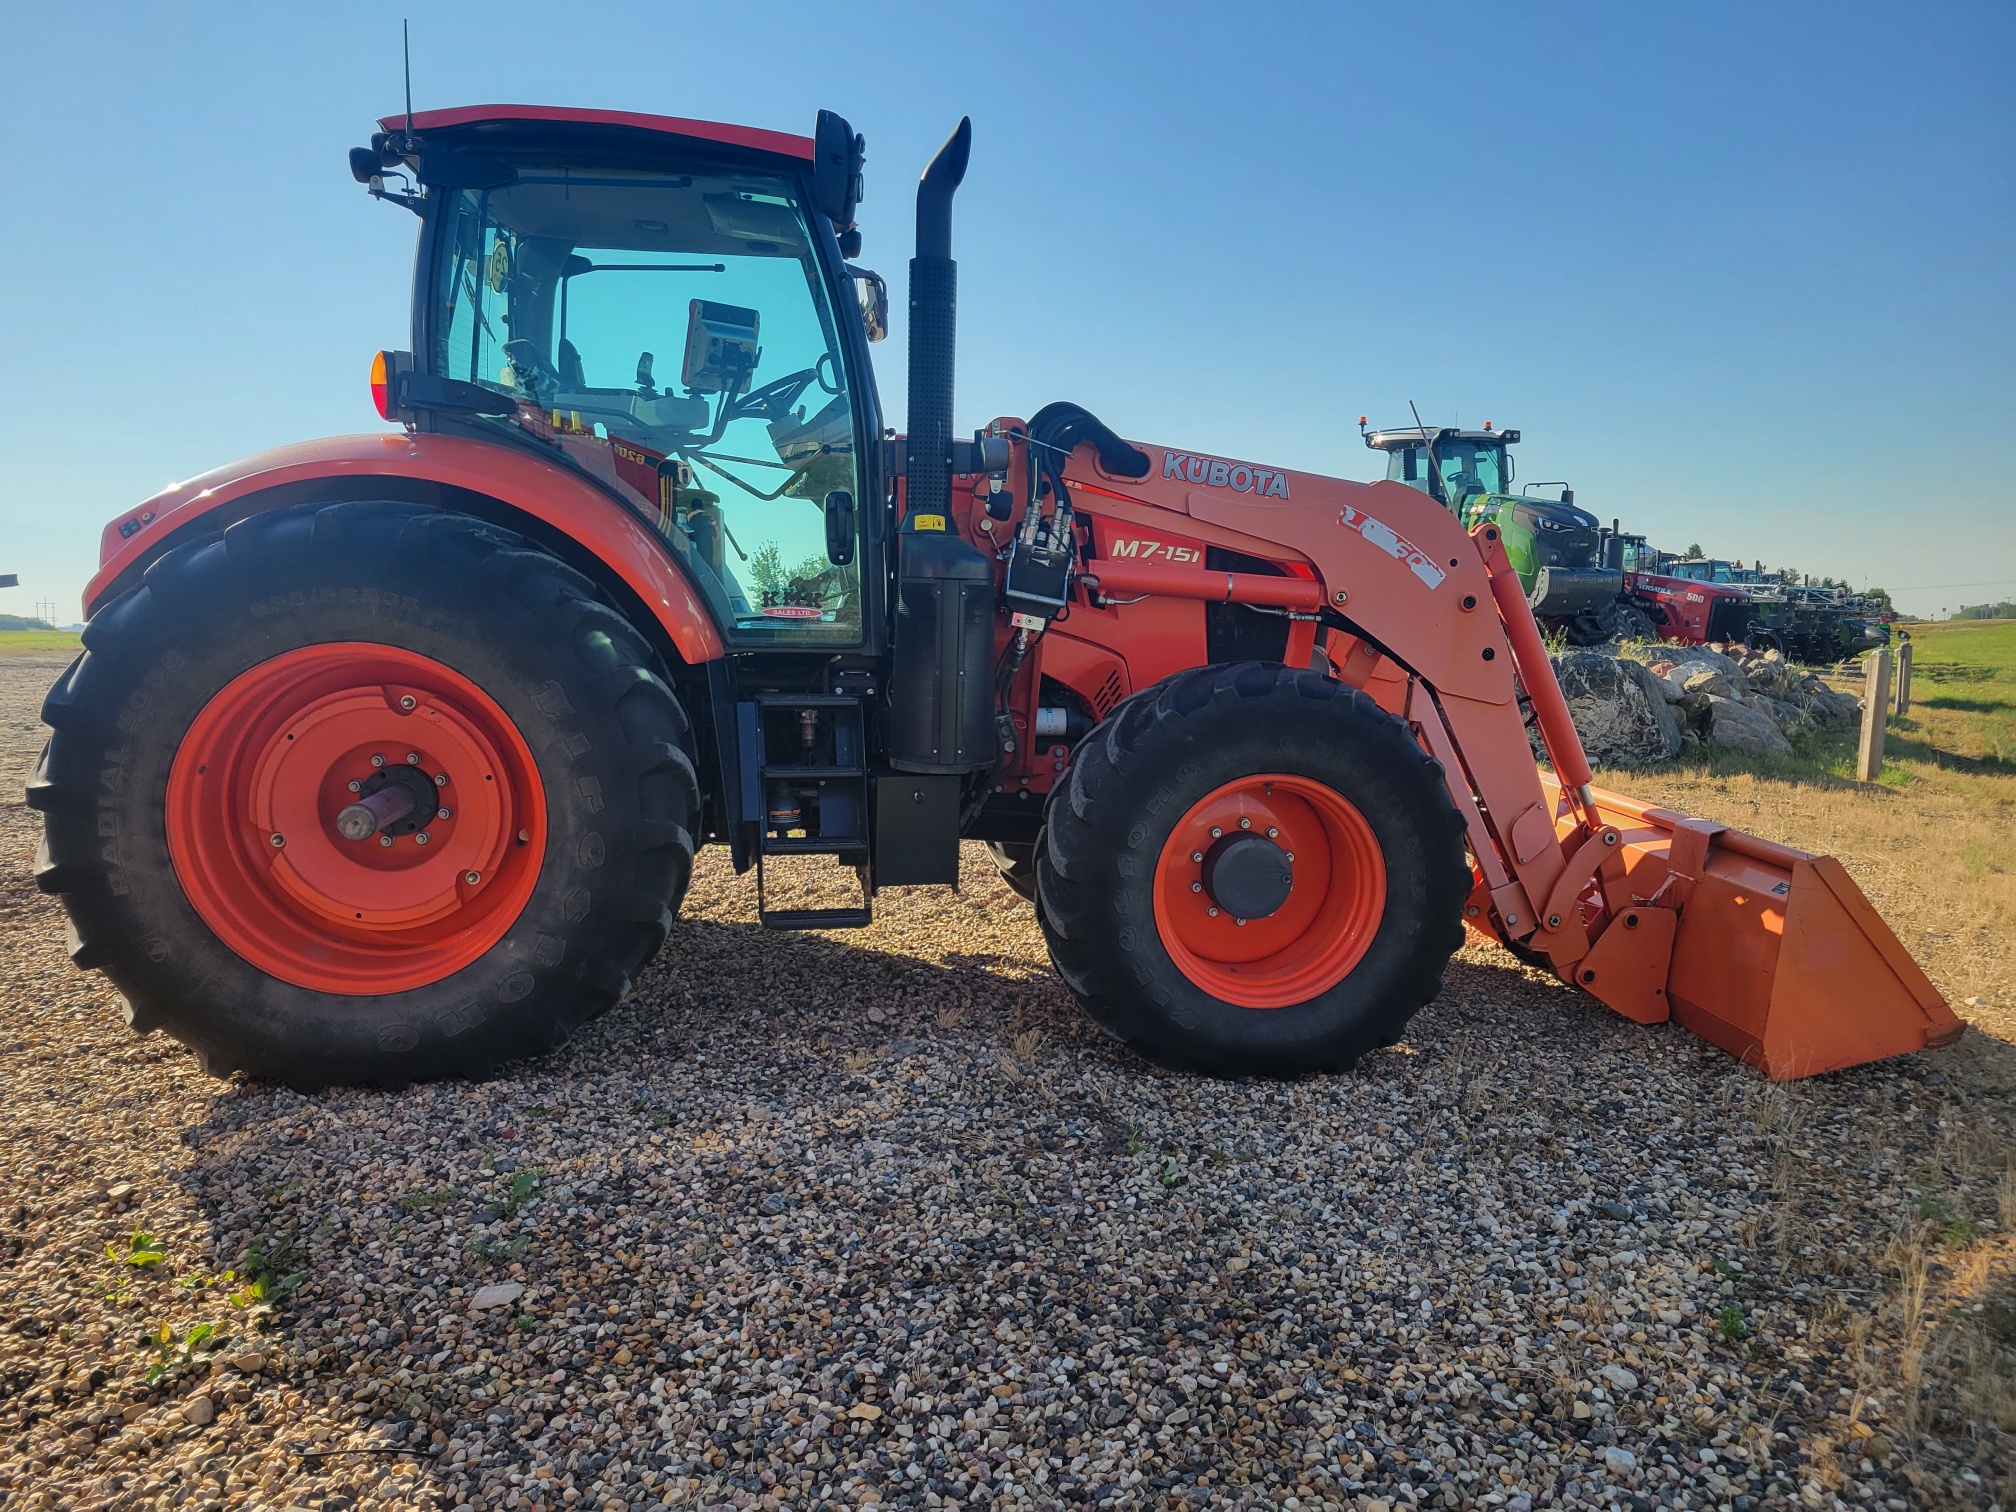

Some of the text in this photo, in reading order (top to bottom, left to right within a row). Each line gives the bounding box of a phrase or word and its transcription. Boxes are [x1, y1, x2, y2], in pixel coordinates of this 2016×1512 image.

[1163, 451, 1289, 500] KUBOTA
[1111, 539, 1201, 563] M7-151
[1638, 584, 1704, 604] VERSATILE 500
[797, 609, 812, 617] LTD.
[98, 744, 131, 897] RADIAL
[377, 679, 607, 1052] Firestone
